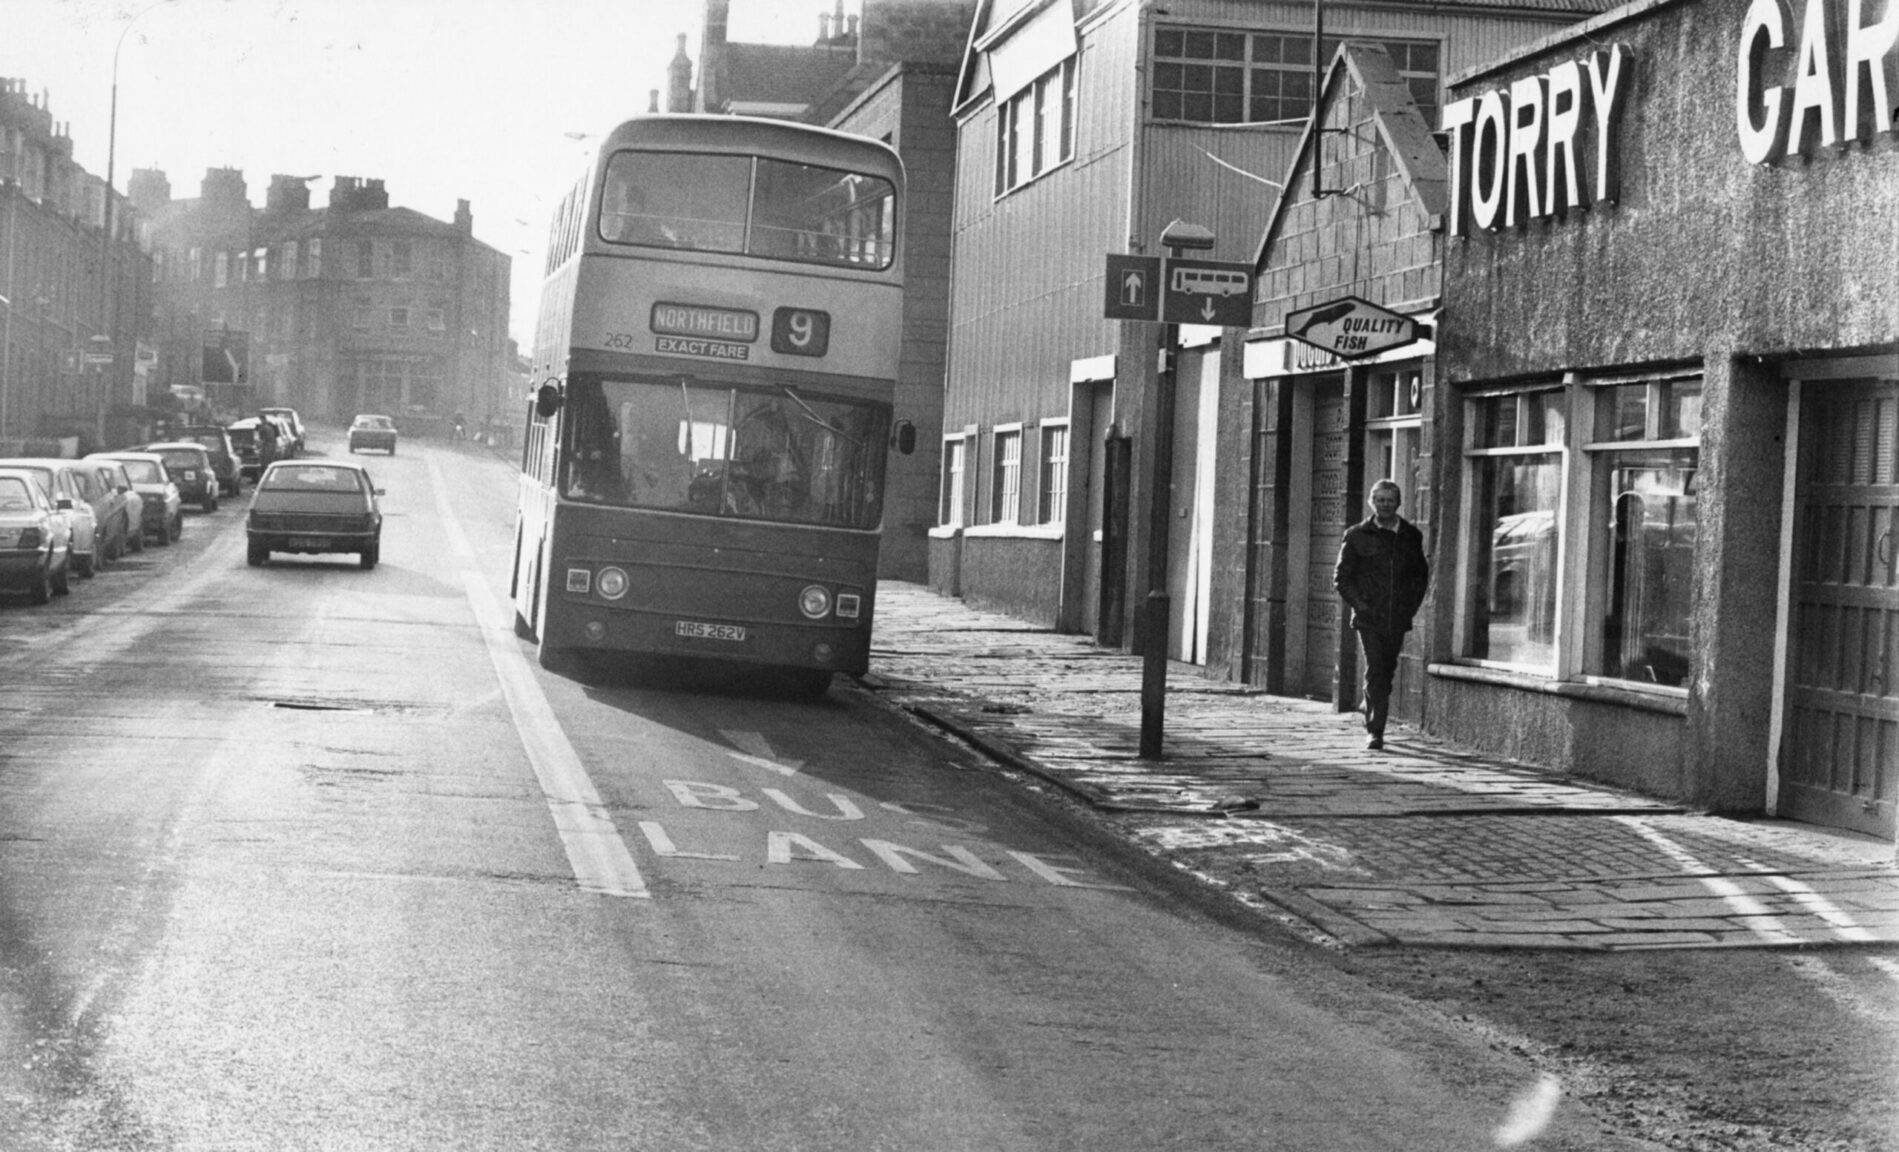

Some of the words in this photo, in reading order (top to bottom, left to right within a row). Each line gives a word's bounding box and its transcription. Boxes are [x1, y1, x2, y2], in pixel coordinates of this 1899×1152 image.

[1738, 0, 1899, 164] GAR
[1441, 43, 1621, 237] TORRY
[655, 308, 753, 335] NORTHFIELD
[788, 312, 812, 347] 9
[1343, 317, 1404, 333] QUALITY
[604, 332, 633, 349] 262
[658, 339, 706, 355] EXACT
[709, 345, 747, 359] FARE
[1334, 335, 1368, 350] FISH
[676, 622, 705, 636] HRS
[707, 625, 745, 640] 262V
[638, 821, 1138, 892] LANE
